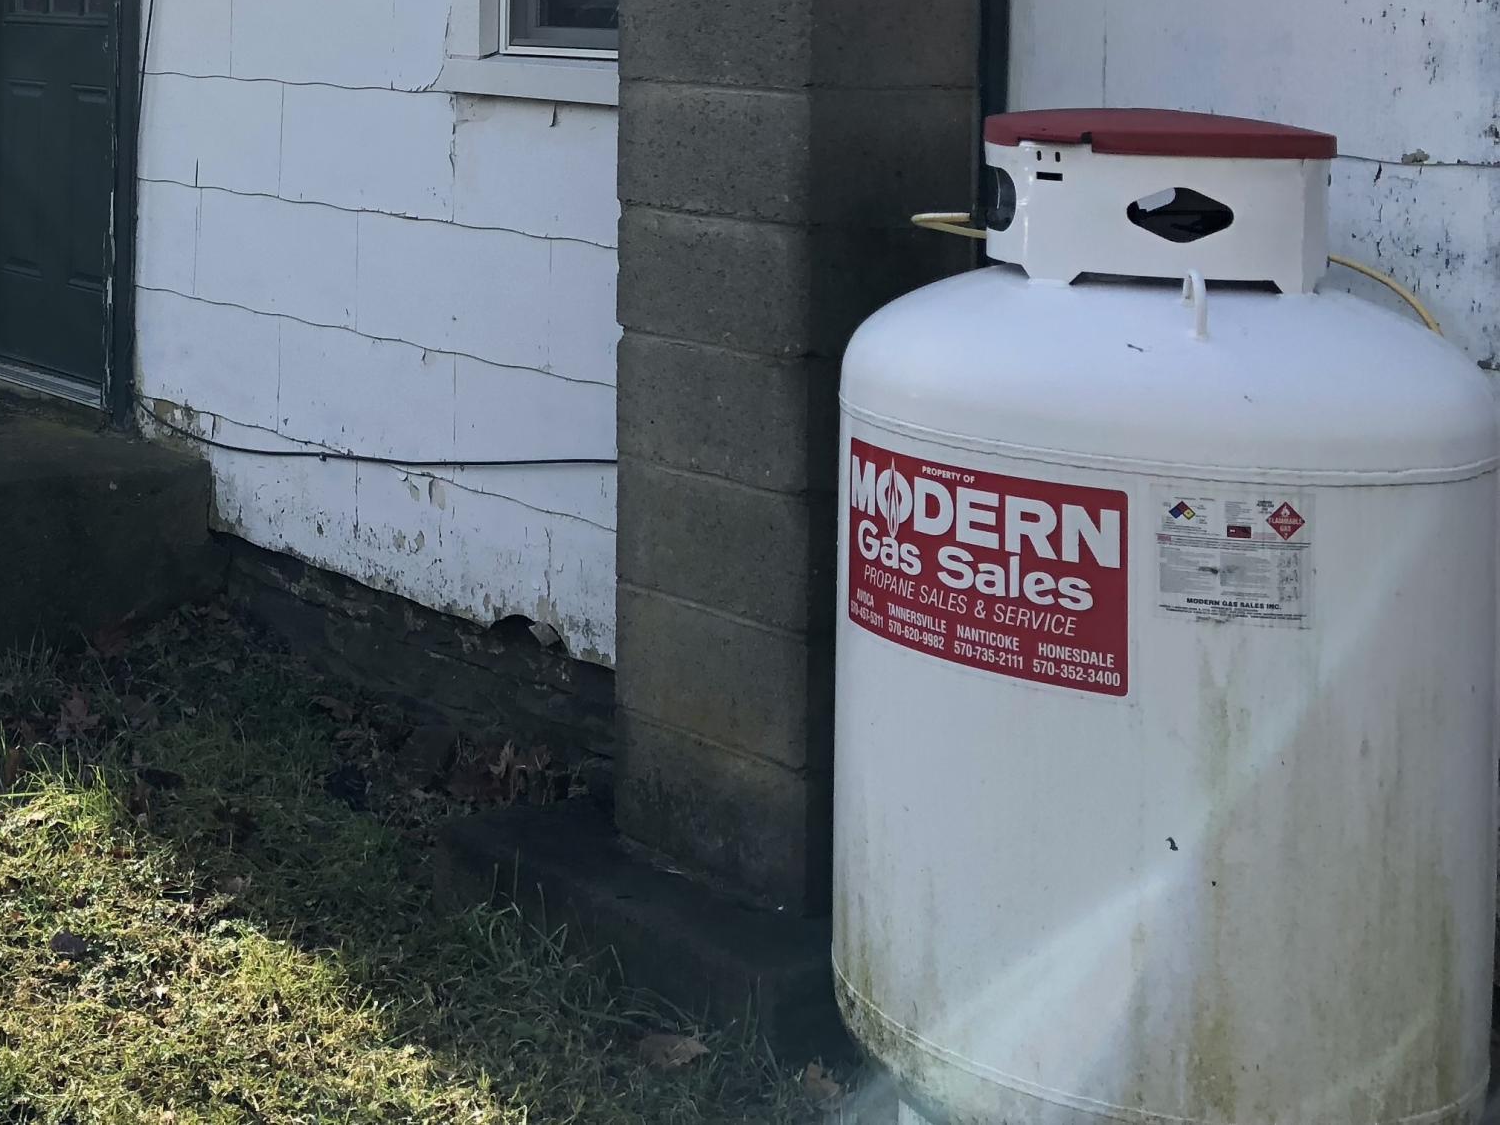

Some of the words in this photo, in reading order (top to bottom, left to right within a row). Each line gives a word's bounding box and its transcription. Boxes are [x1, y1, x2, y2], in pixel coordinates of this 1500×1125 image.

[922, 465, 961, 481] PROPERTY
[963, 474, 975, 484] OF
[851, 453, 1121, 569] MODERN
[857, 519, 922, 576] Gas
[937, 545, 1094, 611] Sales
[863, 564, 916, 600] PROPANE
[918, 585, 967, 614] SALES
[974, 599, 987, 620] &
[992, 603, 1077, 636] SERVICE
[1186, 597, 1220, 607] MODERN
[1222, 600, 1238, 608] GAS
[1240, 601, 1264, 610] SALES
[1266, 602, 1282, 610] INC.
[887, 602, 947, 634] TANNERSVILLE
[956, 624, 1020, 652] NANTICOKE
[1038, 642, 1115, 669] HONESDALE
[888, 619, 945, 650] 570-620-9982
[953, 641, 1024, 670] 570-735-2111
[1032, 658, 1121, 687] 570-352-3400
